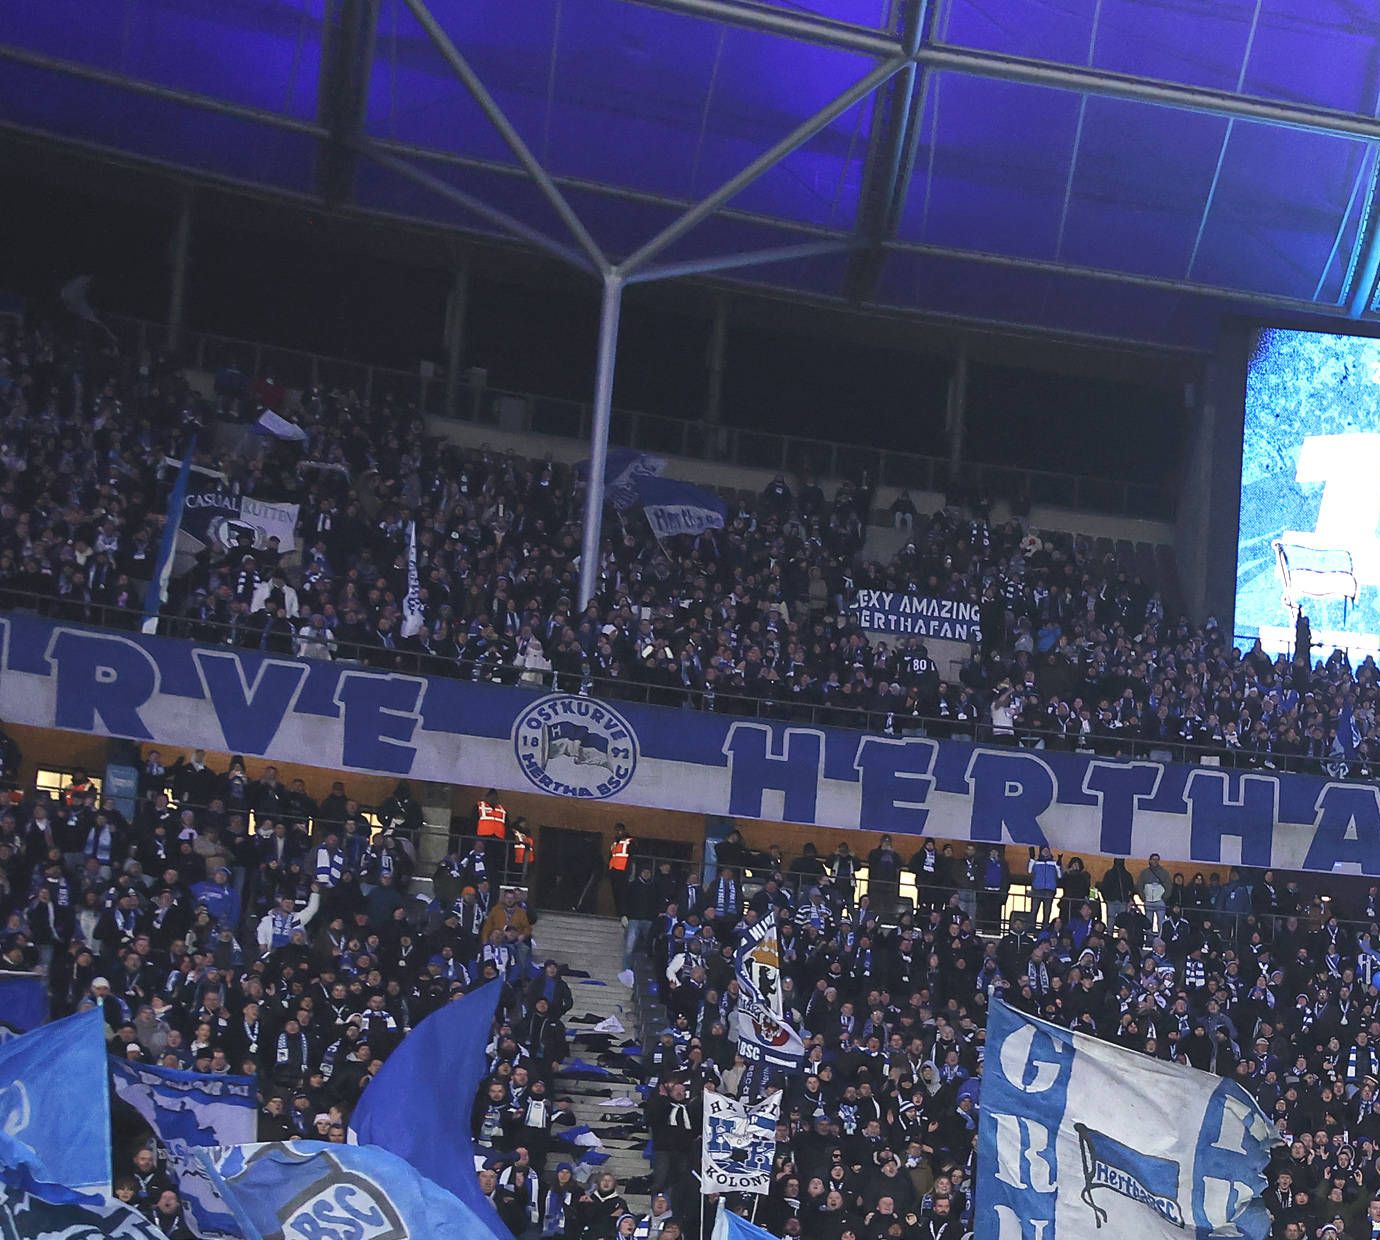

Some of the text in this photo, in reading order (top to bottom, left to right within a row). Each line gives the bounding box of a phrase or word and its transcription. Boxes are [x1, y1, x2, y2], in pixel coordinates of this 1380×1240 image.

[184, 493, 240, 512] CASUAL
[899, 594, 981, 622] AMAZING
[912, 658, 927, 671] 80
[0, 616, 429, 775] RVE
[526, 700, 628, 741] OSTKURVE
[521, 752, 594, 797] HERTHA
[596, 764, 629, 796] BSC
